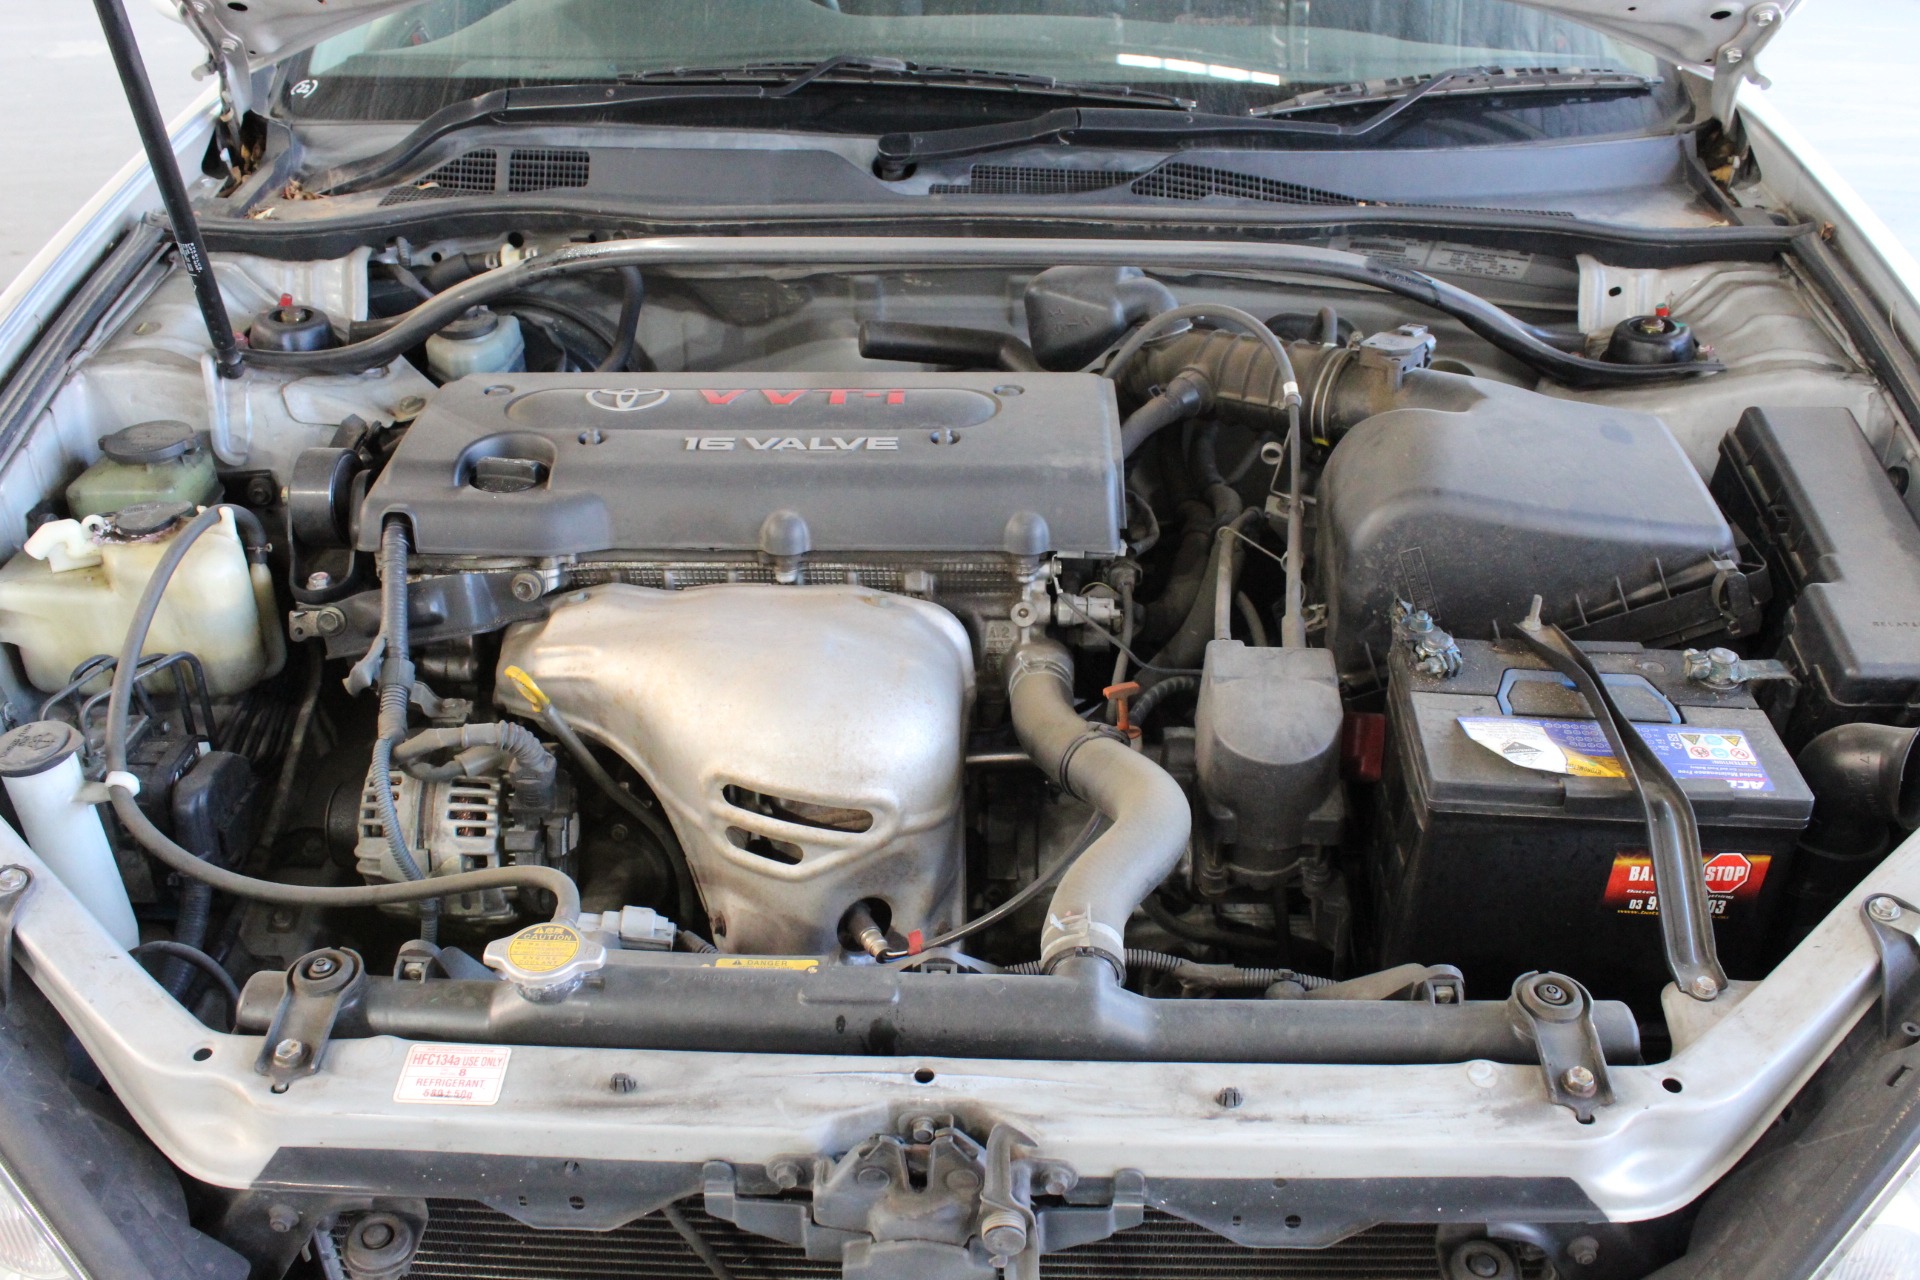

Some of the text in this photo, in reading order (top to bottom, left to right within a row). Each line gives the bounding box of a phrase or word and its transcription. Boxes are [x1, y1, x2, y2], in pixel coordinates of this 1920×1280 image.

[684, 436, 899, 451] 16 VALVE
[1705, 866, 1746, 881] STOP
[1628, 899, 1643, 910] 03
[1646, 896, 1658, 911] 9
[523, 933, 572, 941] CAUTION
[412, 1053, 504, 1067] HFC134a USE ONLY
[458, 1068, 467, 1077] 8
[415, 1078, 486, 1088] REFRIGERANT
